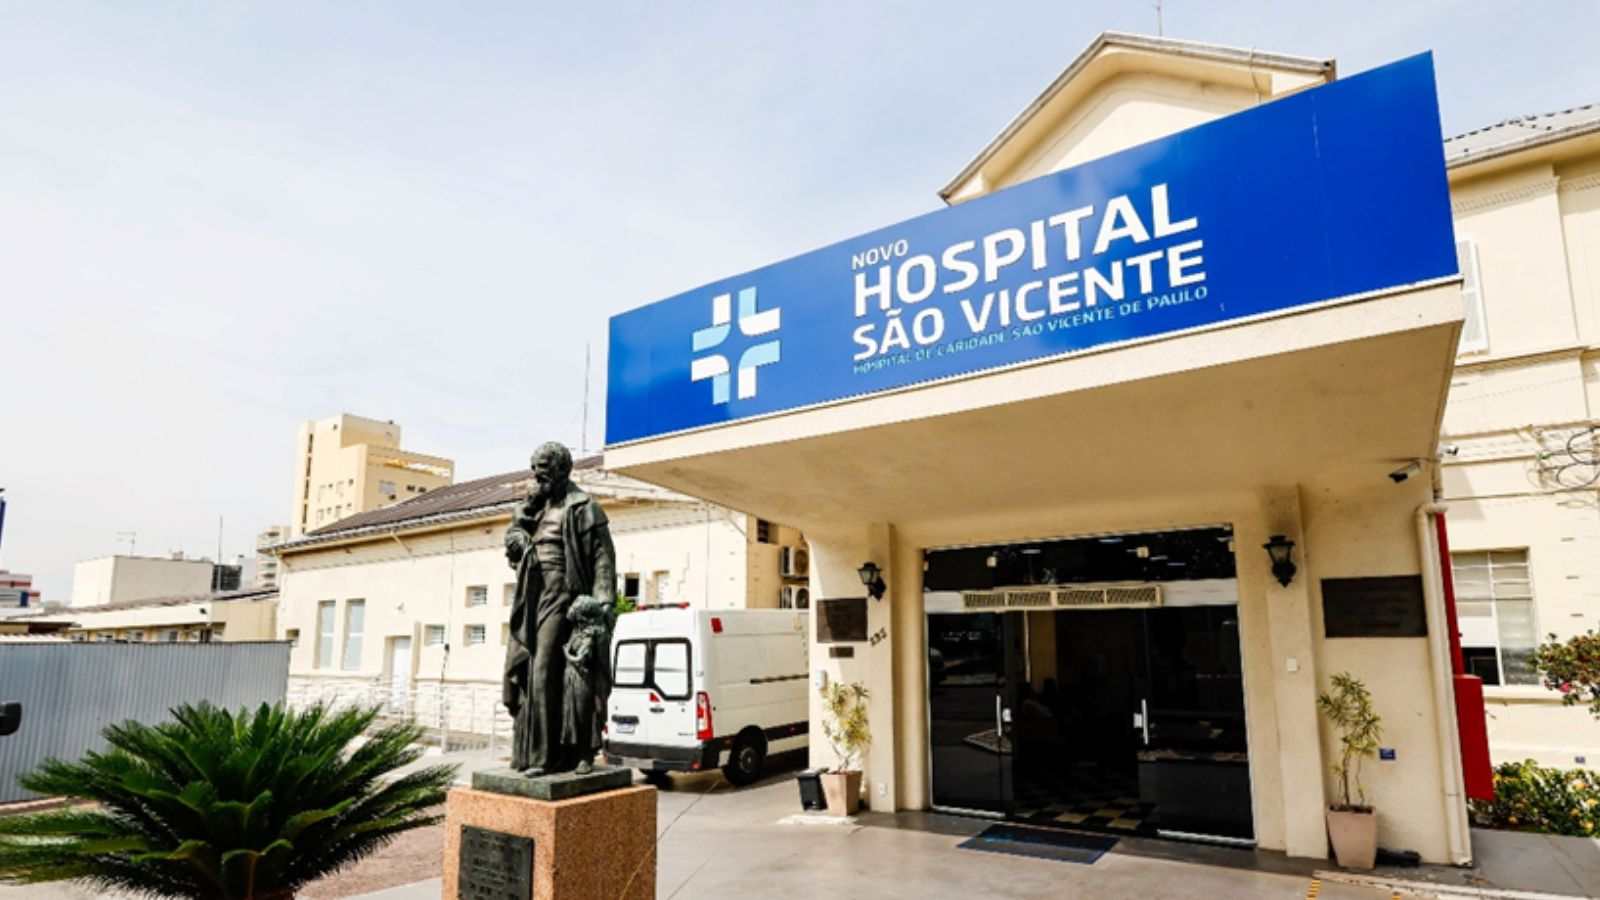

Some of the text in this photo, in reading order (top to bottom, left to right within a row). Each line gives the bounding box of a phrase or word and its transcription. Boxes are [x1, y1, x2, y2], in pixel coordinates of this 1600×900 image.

[852, 239, 909, 270] NOVO
[855, 184, 1198, 317] HOSPITAL
[853, 240, 1206, 361] SÃO VICENTE
[1048, 306, 1115, 332] VICENTE
[1119, 300, 1142, 316] DE
[1146, 286, 1208, 311] PAULO
